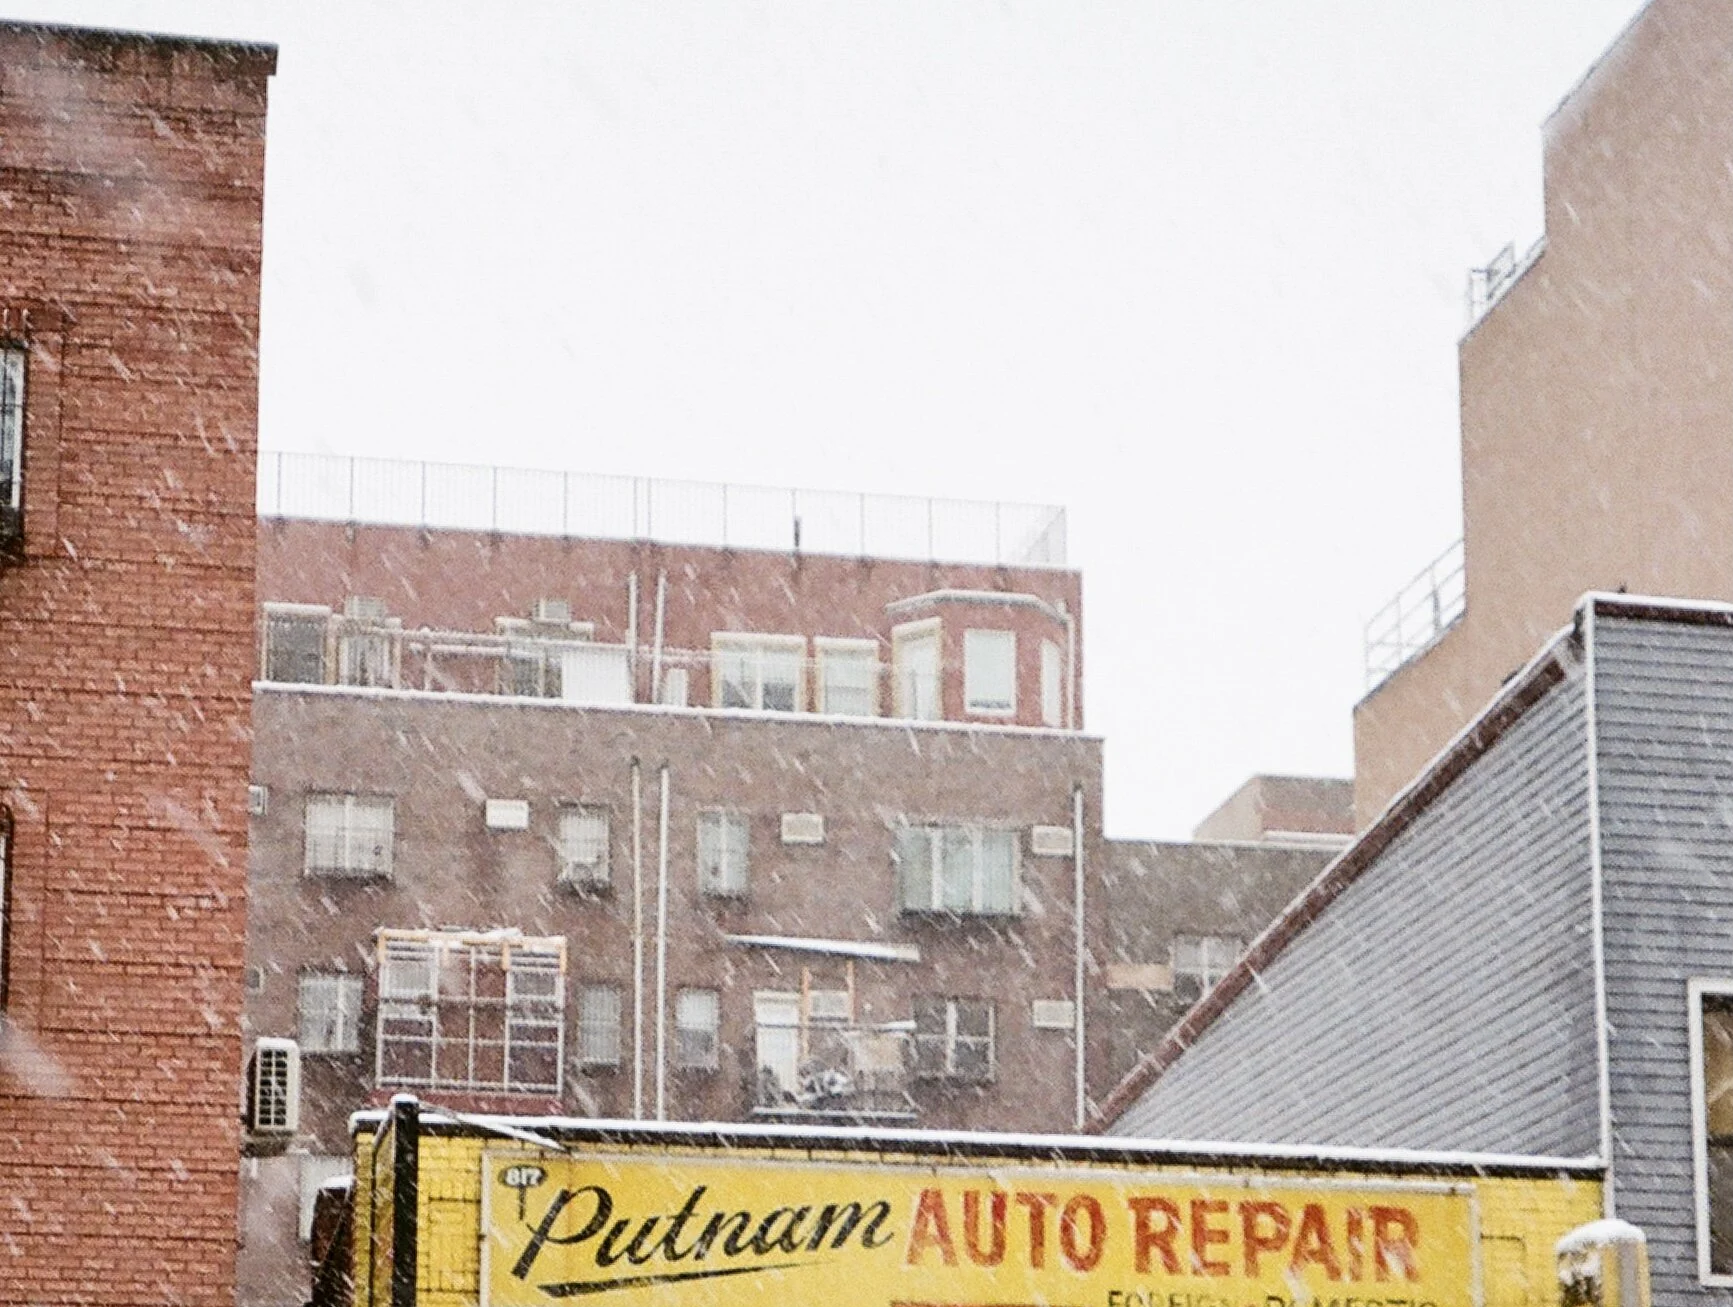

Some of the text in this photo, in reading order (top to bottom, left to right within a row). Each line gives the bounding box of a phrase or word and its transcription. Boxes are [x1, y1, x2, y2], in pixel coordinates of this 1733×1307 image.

[512, 1184, 1420, 1283] Putnam AUTO REPAIR
